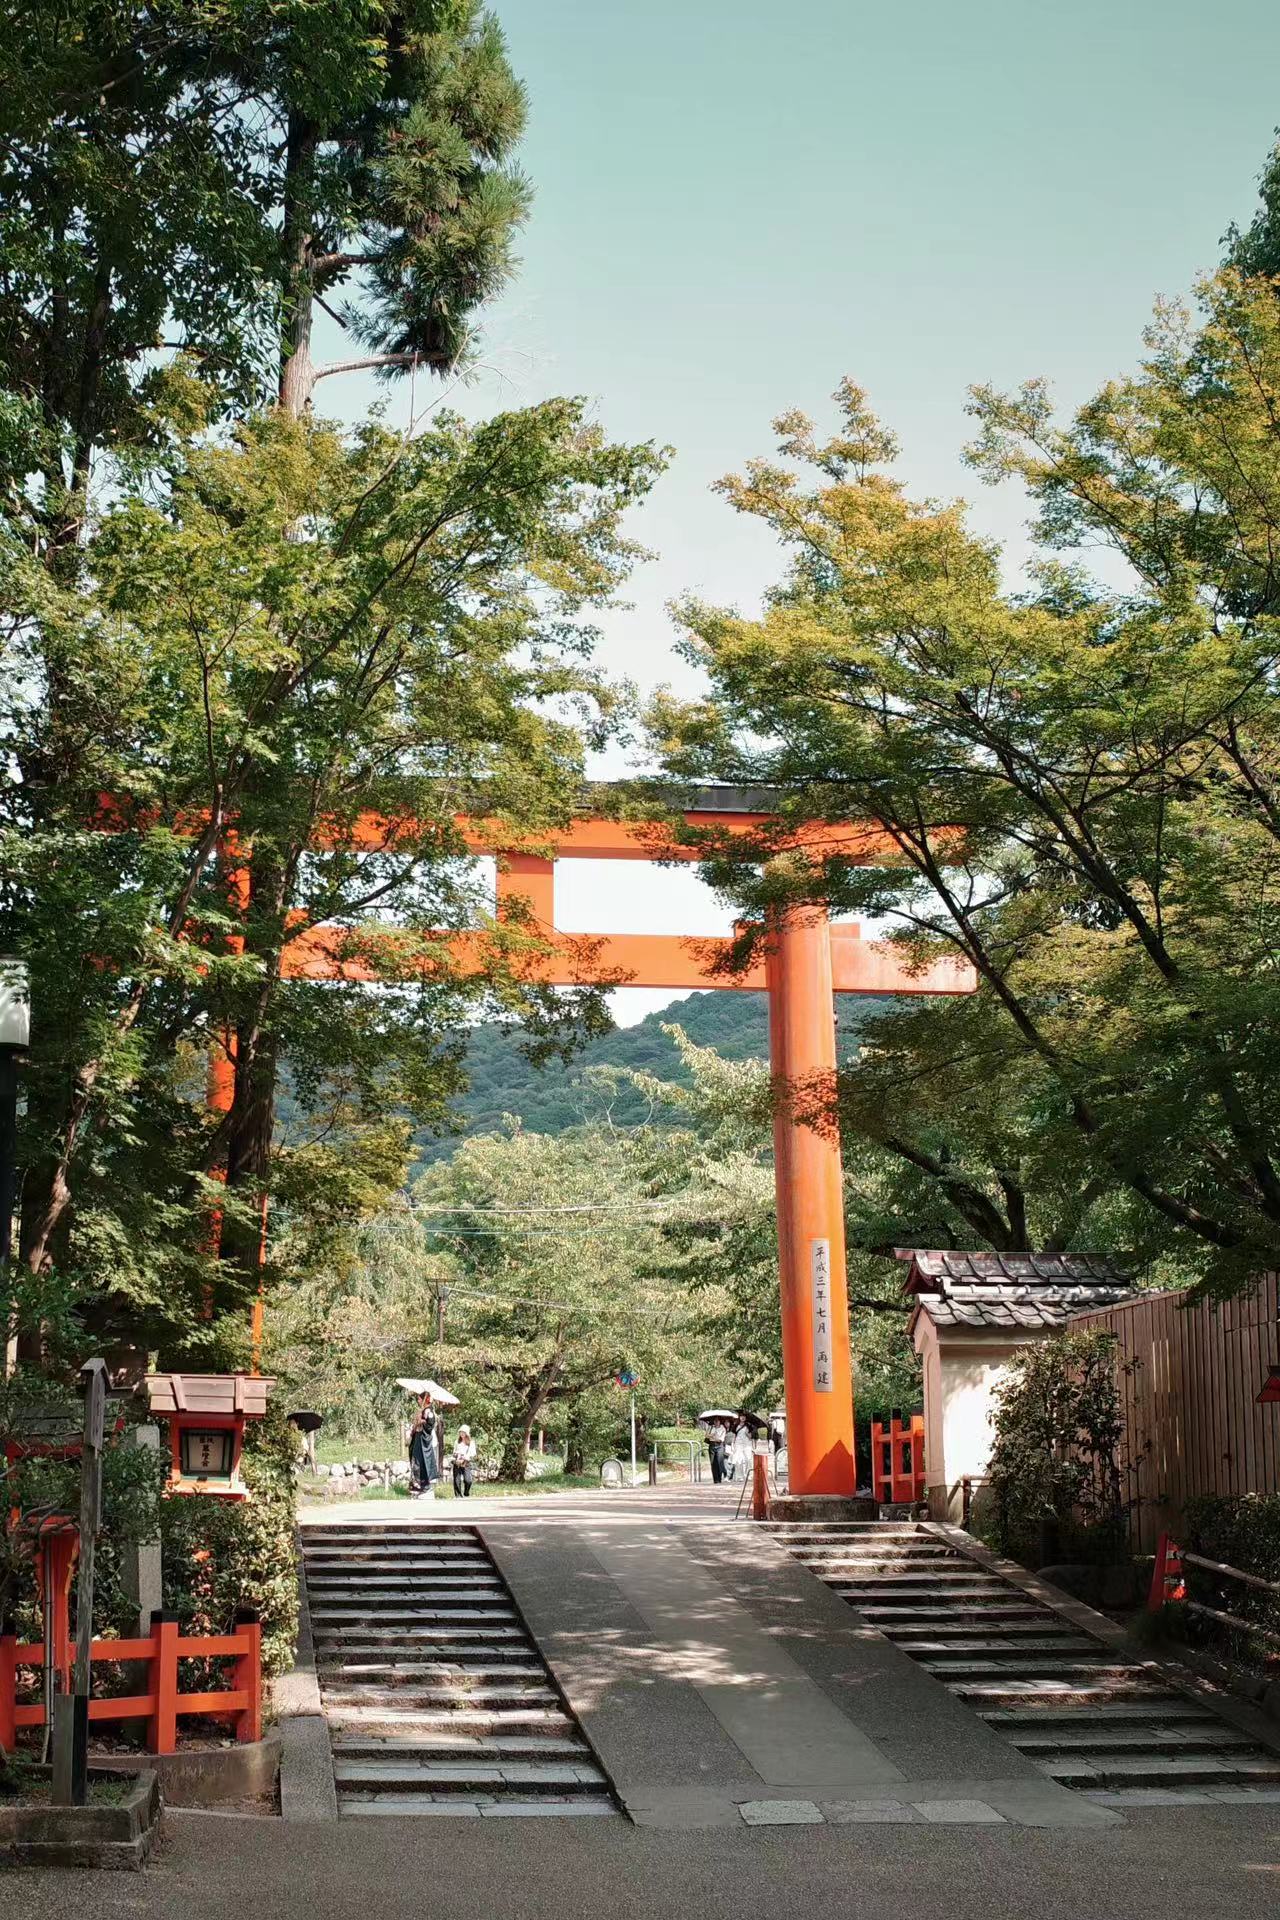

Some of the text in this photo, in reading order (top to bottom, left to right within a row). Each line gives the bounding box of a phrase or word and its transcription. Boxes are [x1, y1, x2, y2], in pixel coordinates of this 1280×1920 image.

[815, 1245, 828, 1334] 平成三年七月
